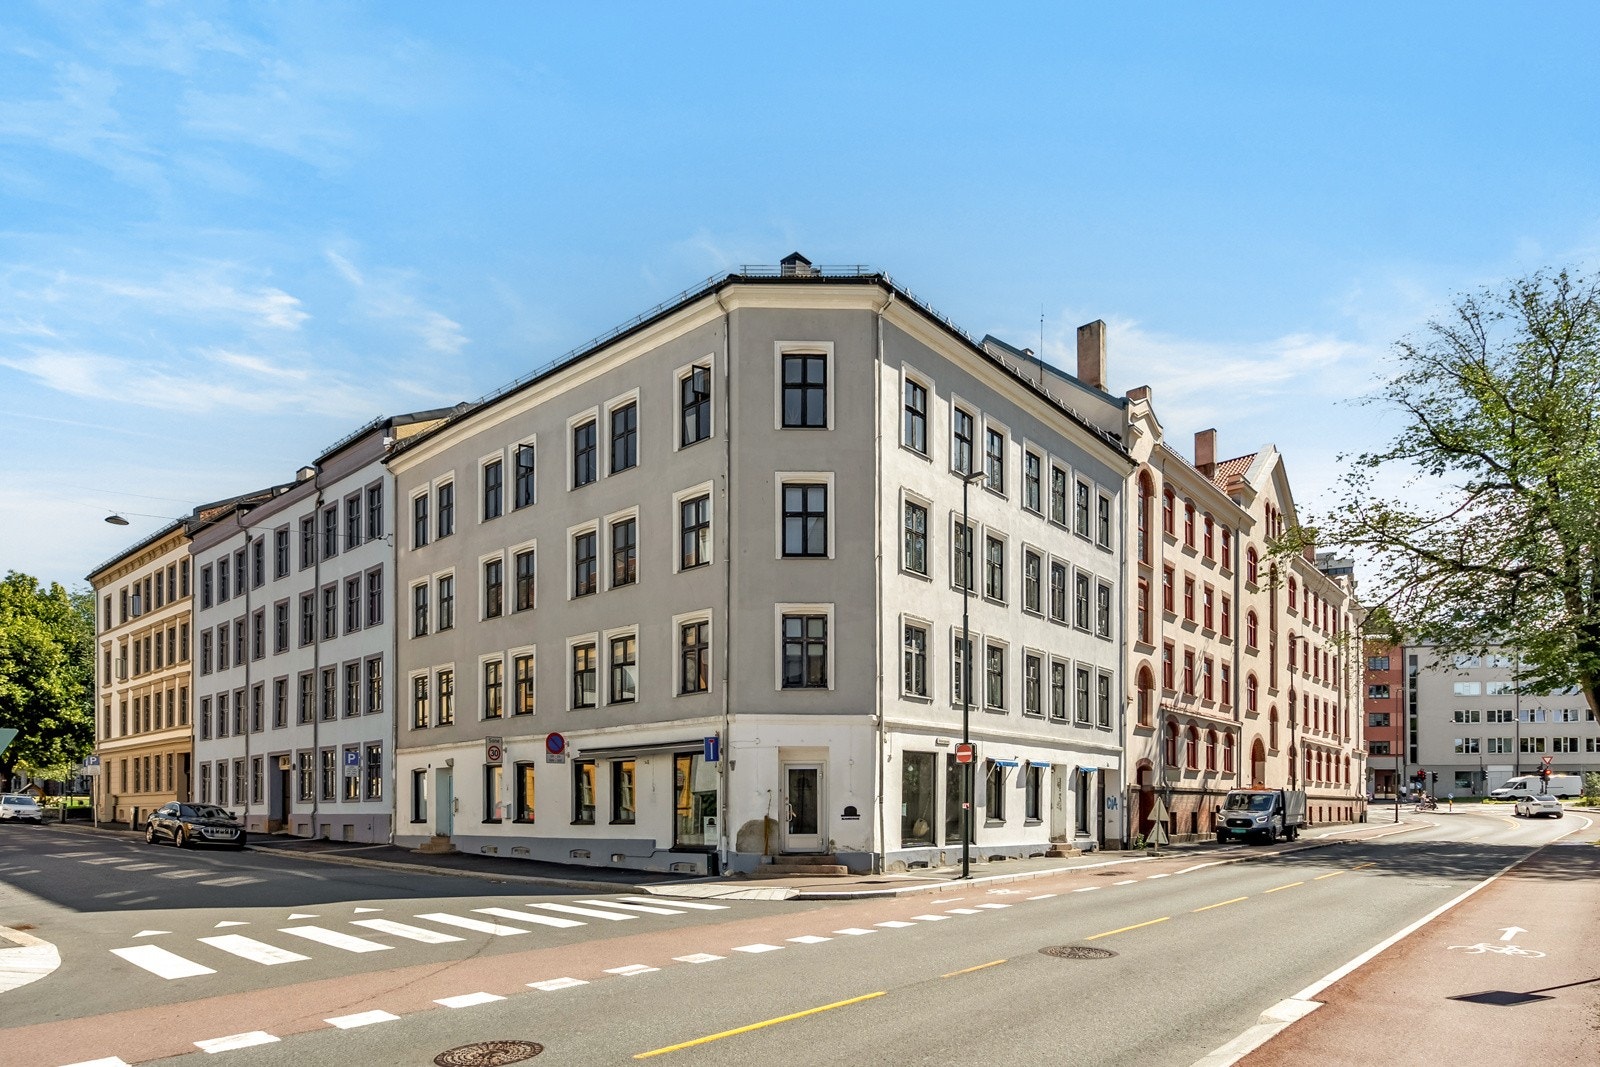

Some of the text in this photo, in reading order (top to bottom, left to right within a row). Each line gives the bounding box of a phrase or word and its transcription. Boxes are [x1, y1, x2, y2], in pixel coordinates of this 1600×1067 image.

[490, 749, 499, 757] 30
[90, 756, 97, 765] P
[348, 753, 356, 764] P
